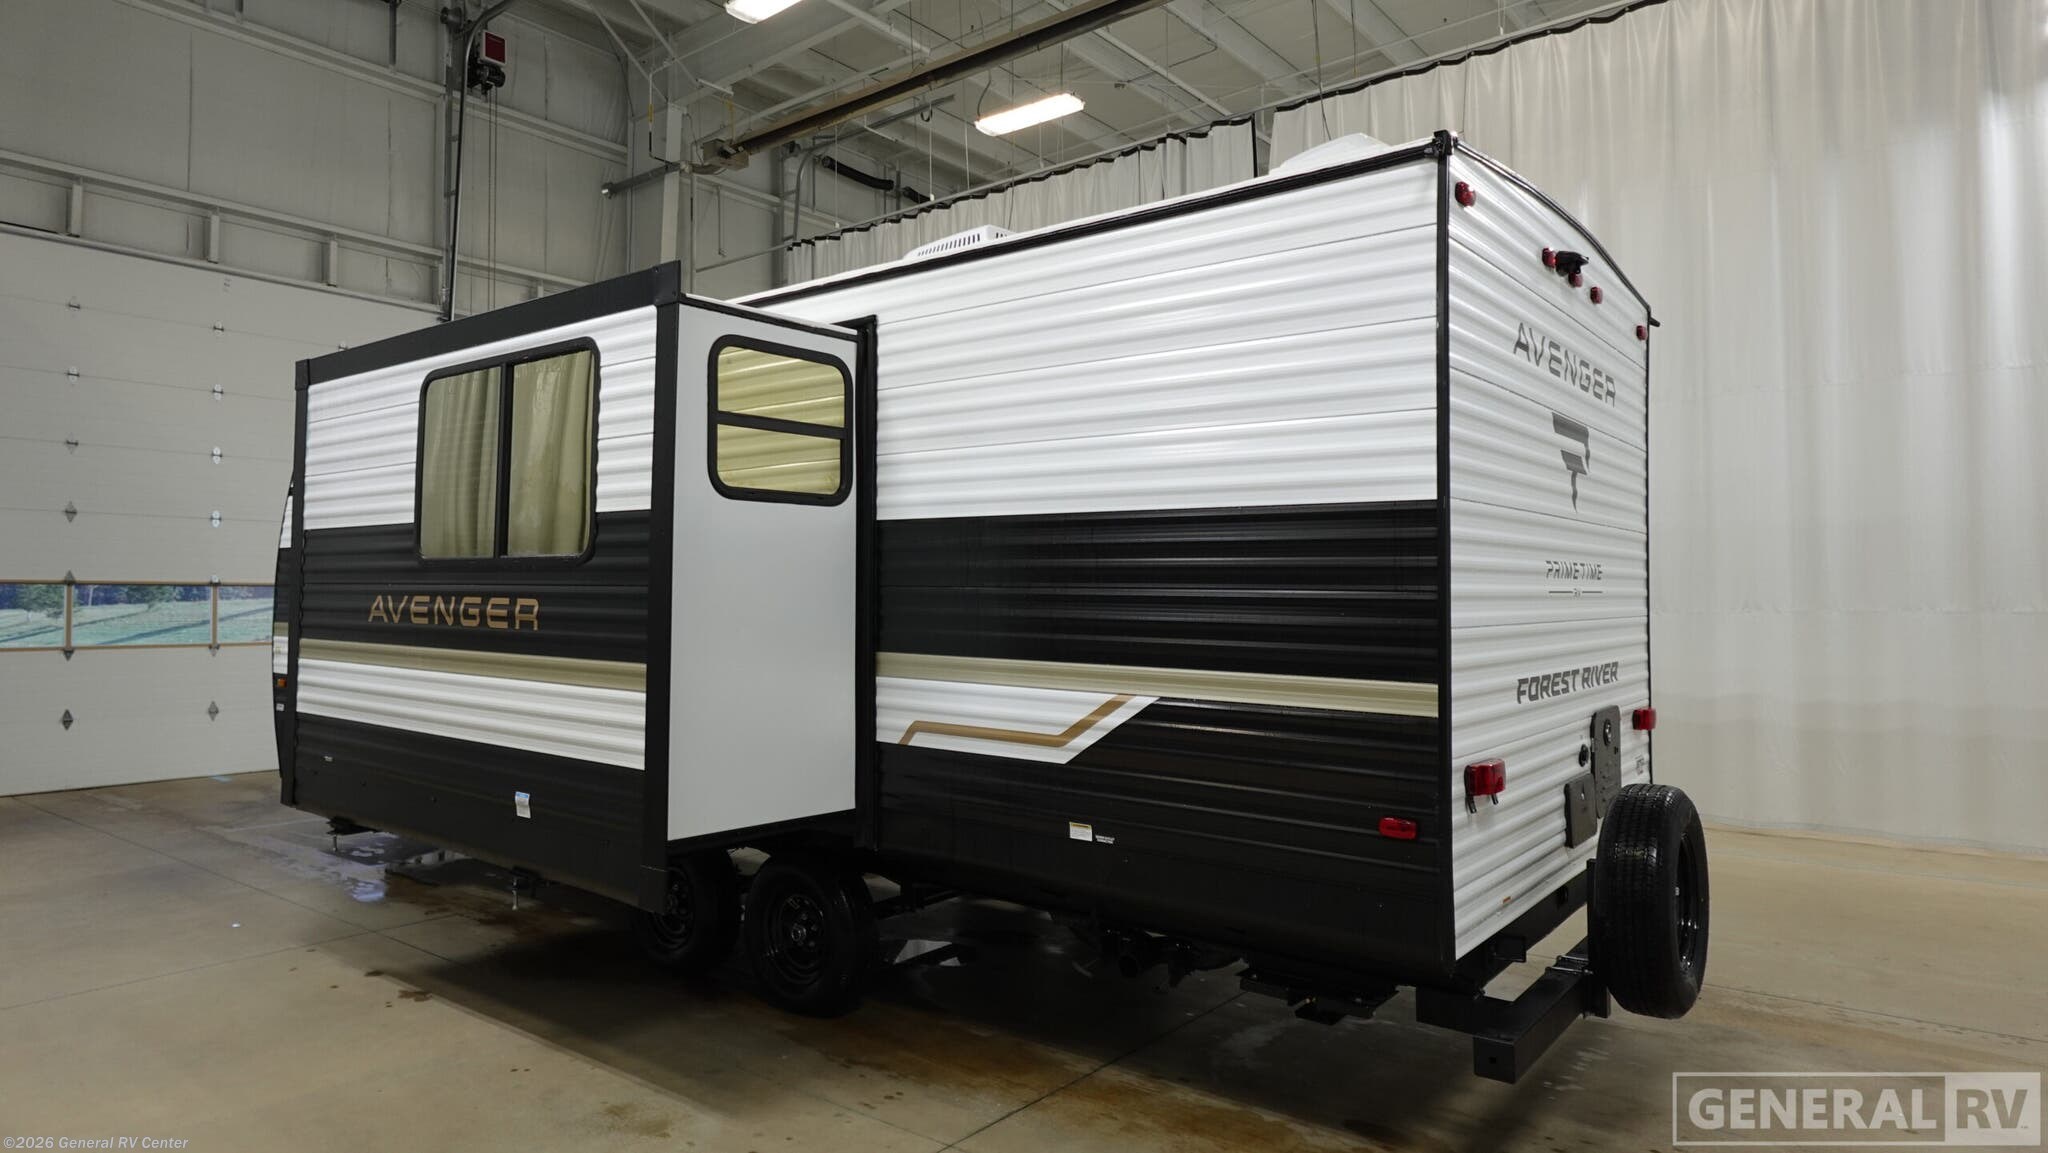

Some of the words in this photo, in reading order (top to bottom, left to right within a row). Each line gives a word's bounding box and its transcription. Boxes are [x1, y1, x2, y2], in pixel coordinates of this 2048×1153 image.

[1513, 322, 1616, 408] AVENGER
[368, 595, 540, 631] AVENGER
[1517, 669, 1580, 704] FOREST
[1582, 661, 1619, 689] RIVER
